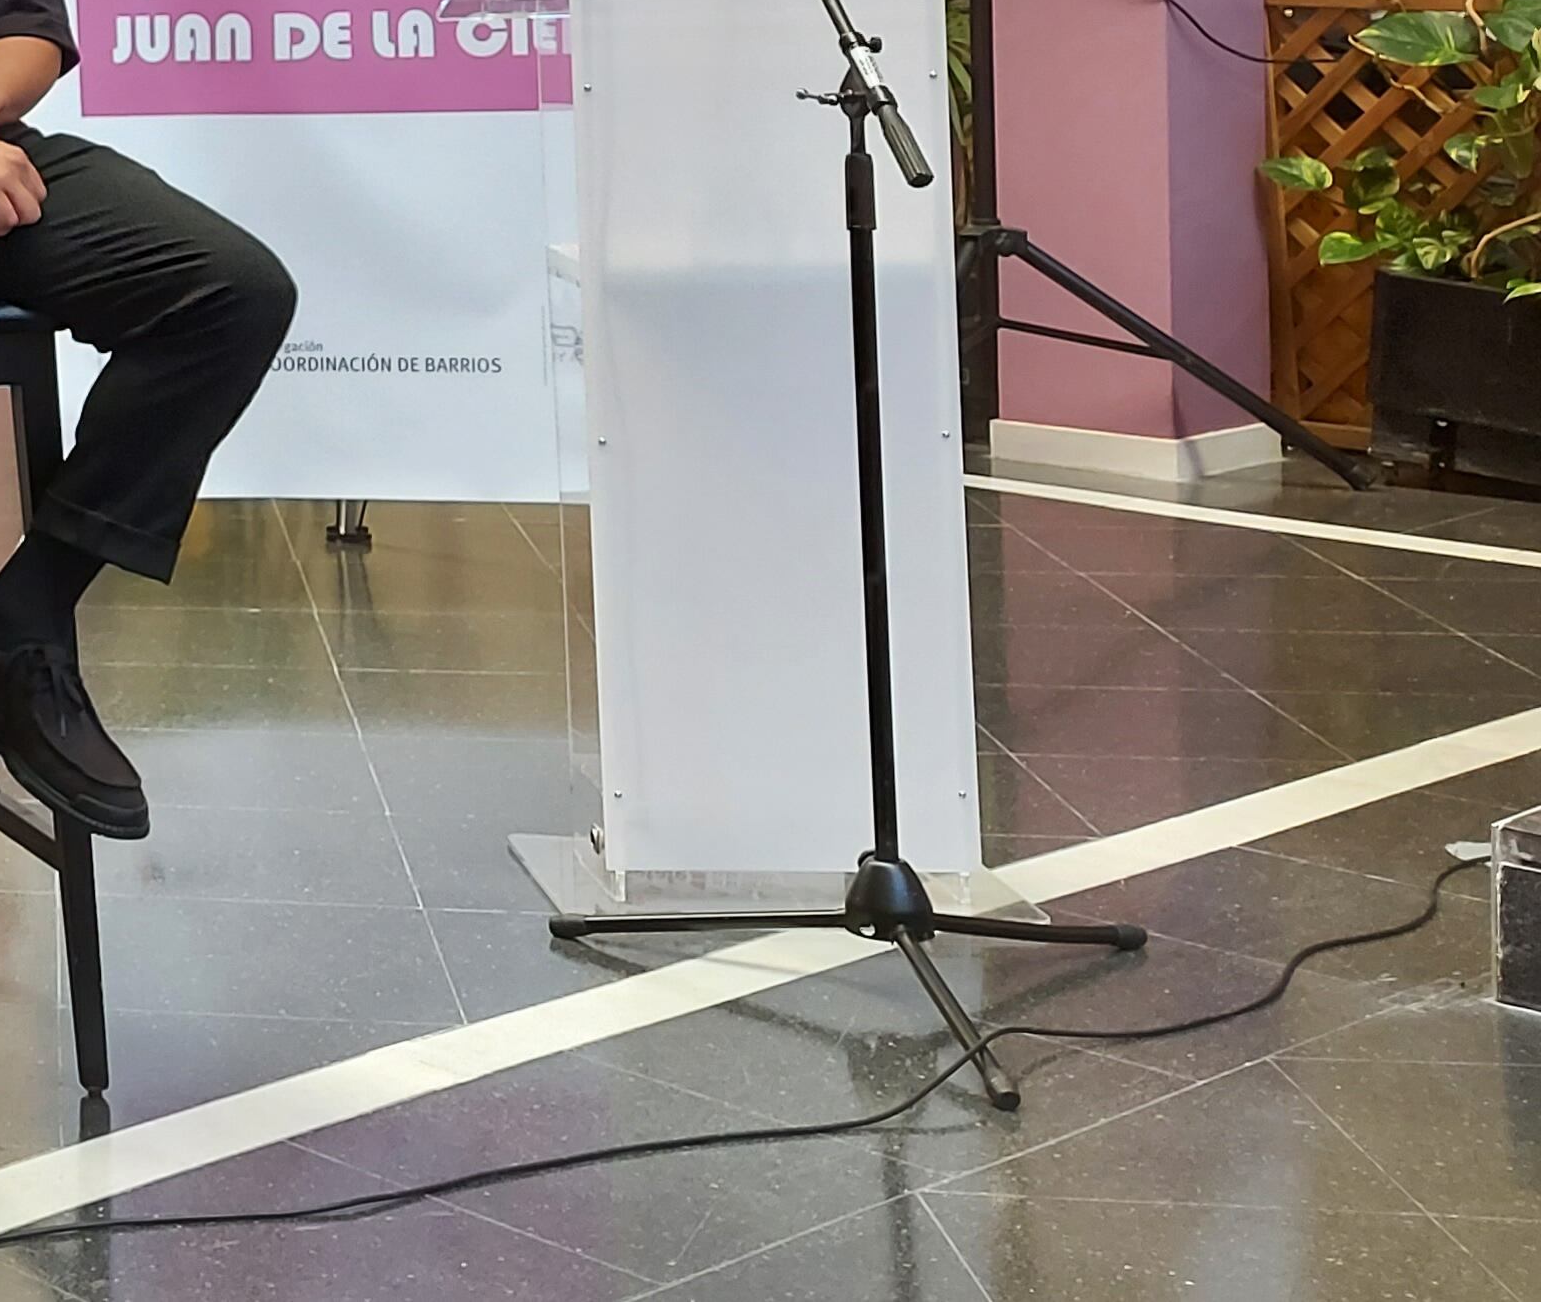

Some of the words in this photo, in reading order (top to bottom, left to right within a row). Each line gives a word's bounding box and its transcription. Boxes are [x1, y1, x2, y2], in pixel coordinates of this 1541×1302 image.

[113, 13, 252, 64] JUAN
[274, 11, 353, 60] DE
[372, 9, 435, 58] LA
[455, 15, 572, 58] CIE
[398, 356, 419, 372] DE
[425, 357, 502, 373] BARRIOS
